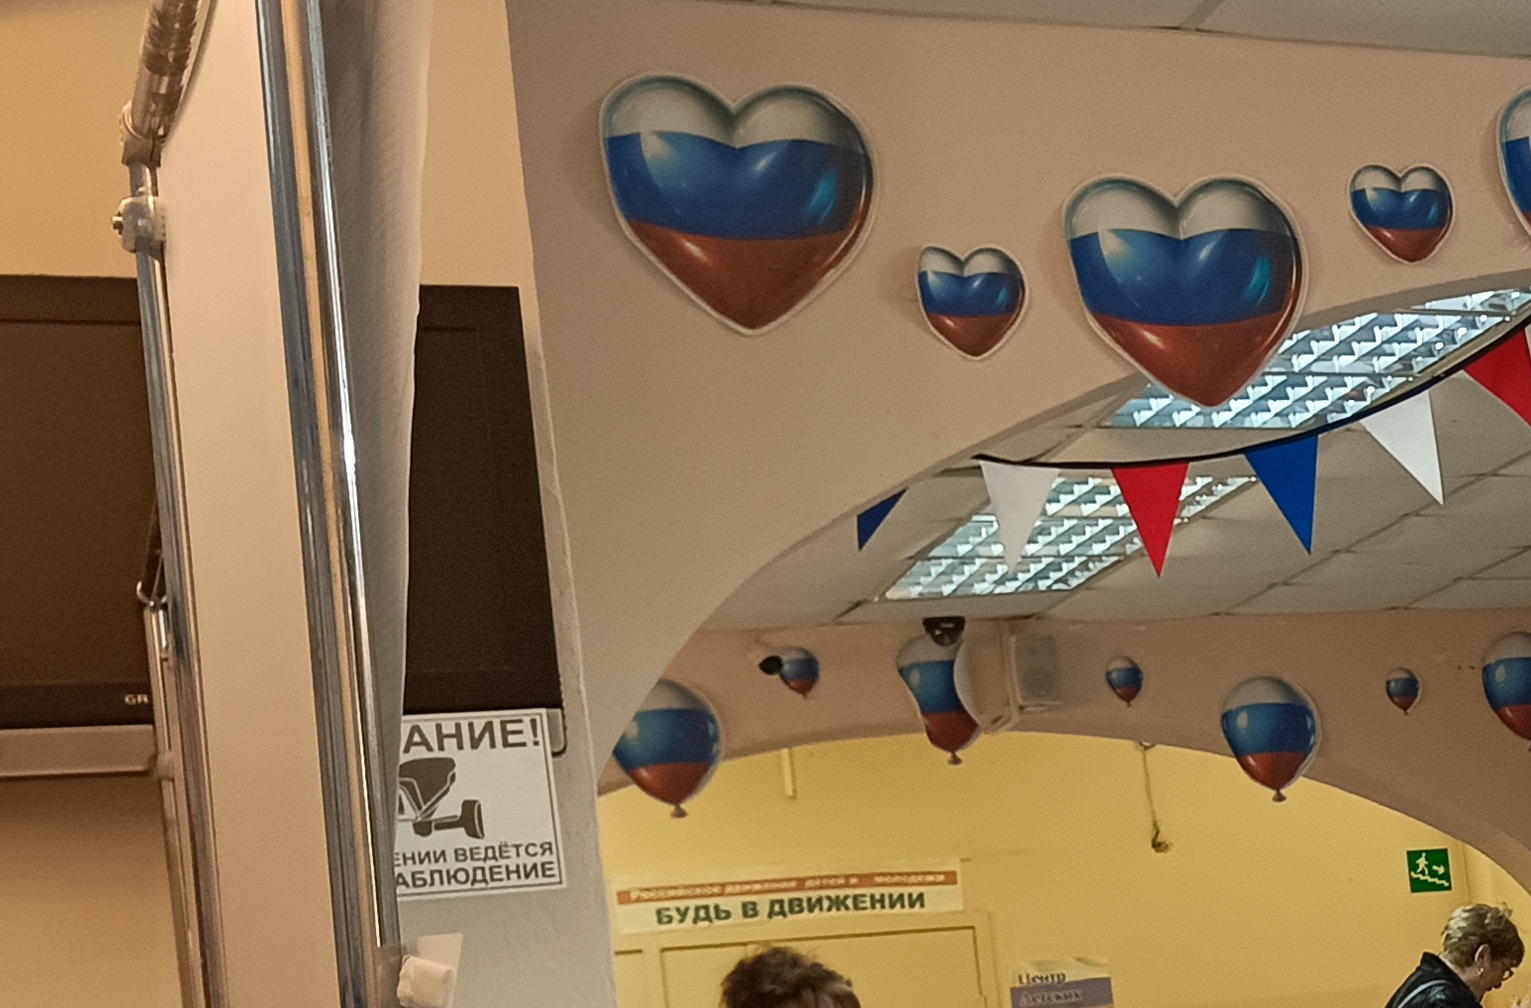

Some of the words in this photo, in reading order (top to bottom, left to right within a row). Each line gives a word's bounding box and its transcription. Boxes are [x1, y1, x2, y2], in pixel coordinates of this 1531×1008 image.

[403, 718, 540, 754] АНИЕ!
[454, 841, 553, 863] ВЕДЁТСЯ
[396, 861, 556, 889] АБЛЮДЕНИЕ
[655, 903, 731, 925] БУДЬ
[741, 901, 759, 918] В
[767, 892, 925, 919] ДВИЖЕНИИ
[1018, 972, 1066, 985] Центр
